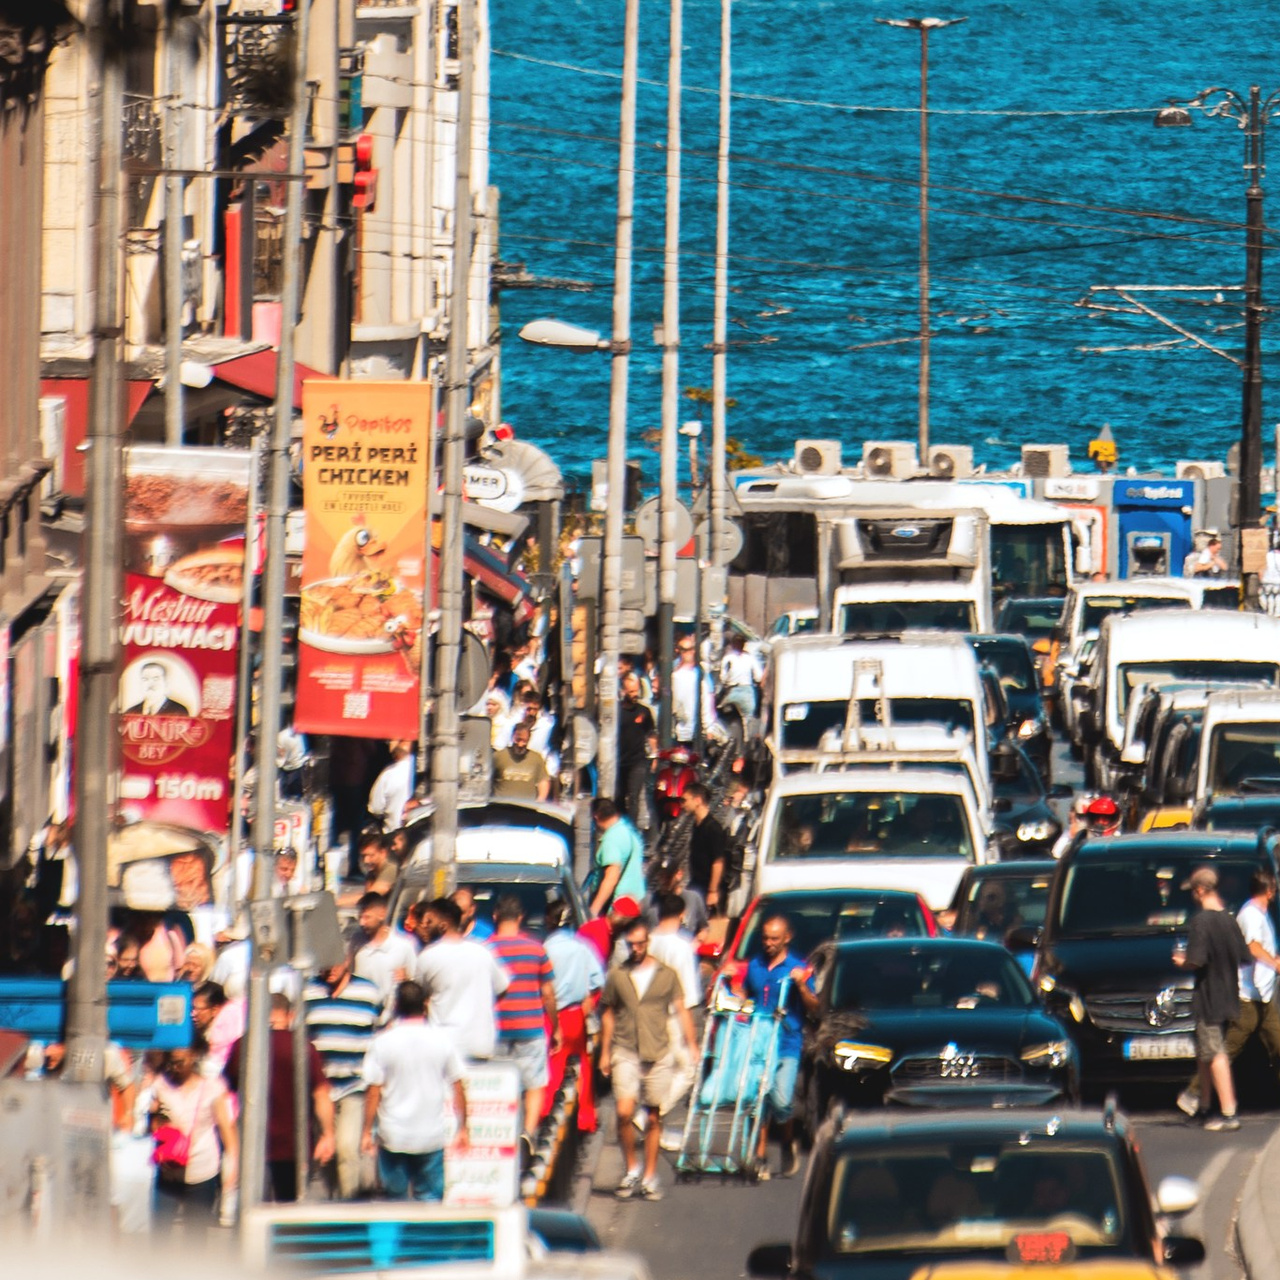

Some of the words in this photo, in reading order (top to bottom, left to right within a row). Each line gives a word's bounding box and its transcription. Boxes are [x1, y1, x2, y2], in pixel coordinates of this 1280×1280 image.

[311, 442, 361, 463] PERİ
[368, 443, 418, 465] PERİ
[318, 468, 409, 486] CHICKEN
[469, 476, 499, 487] MER
[138, 745, 168, 760] BEY
[154, 775, 224, 801] 150m
